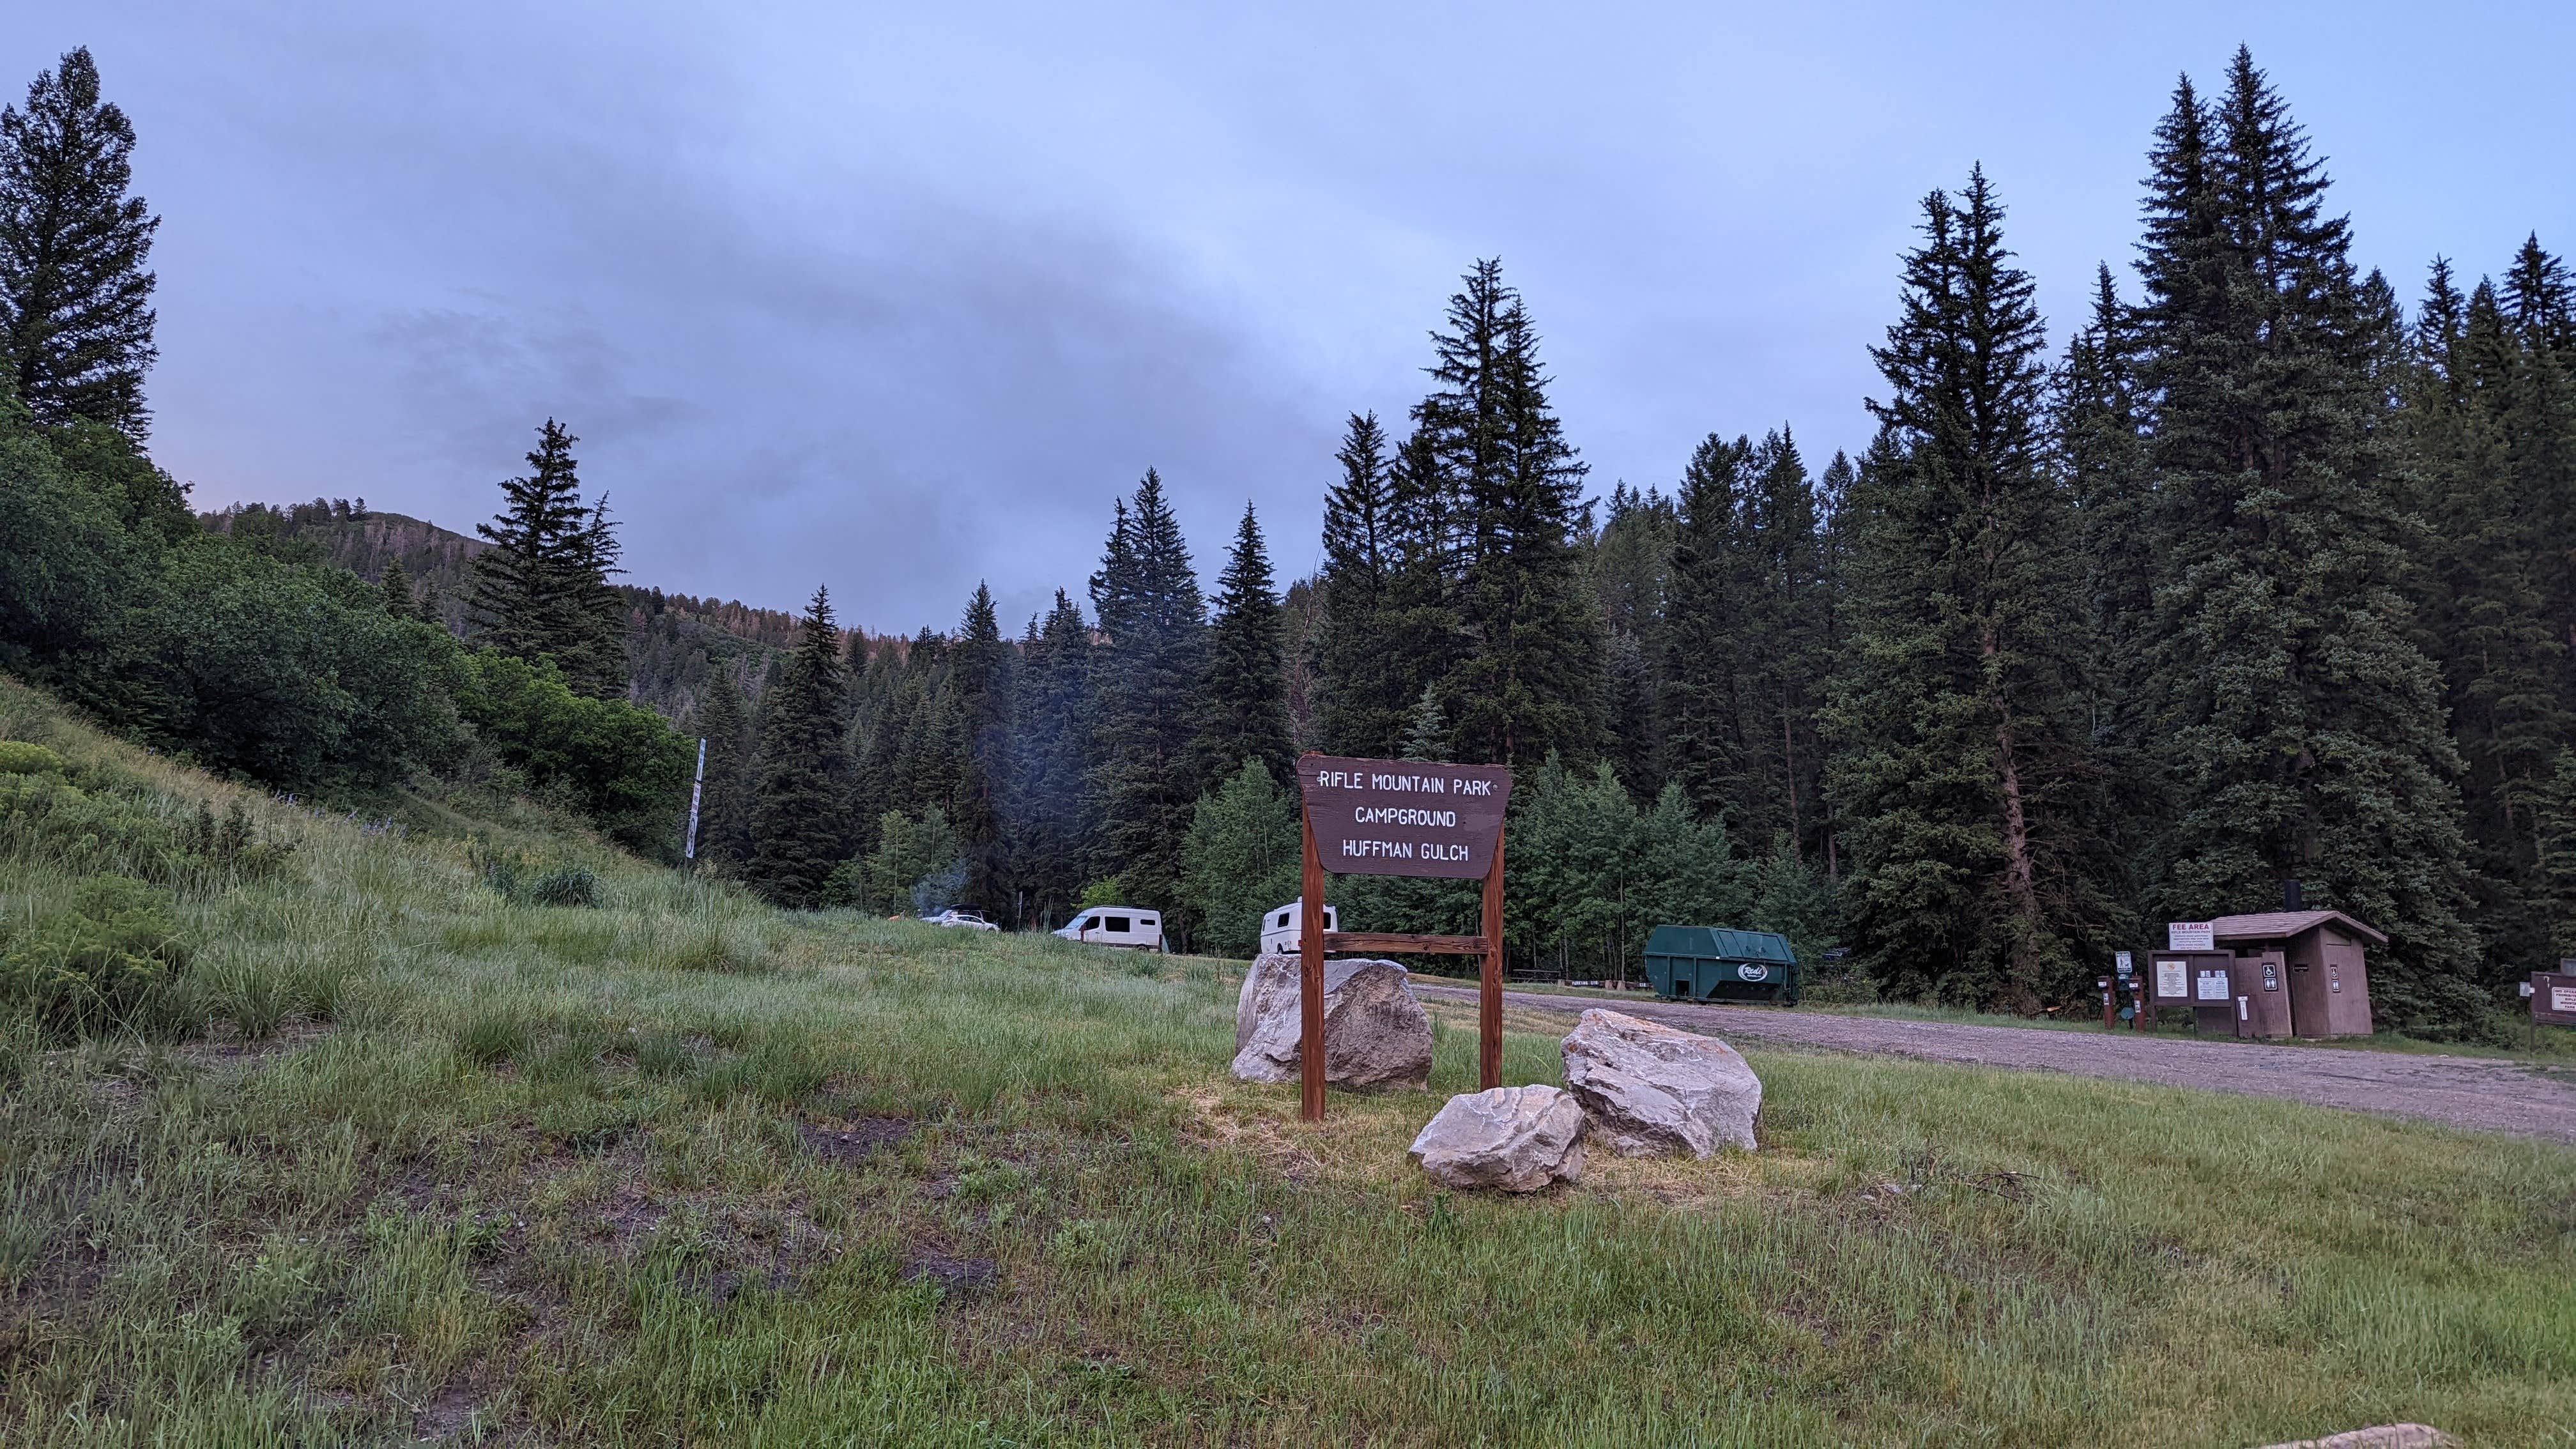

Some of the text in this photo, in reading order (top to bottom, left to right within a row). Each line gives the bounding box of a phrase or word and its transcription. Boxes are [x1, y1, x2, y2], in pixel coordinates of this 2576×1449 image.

[1320, 771, 1492, 796] RIFLE MOUNTAIN PARK
[1355, 807, 1456, 827] CAMPGROUND
[1343, 839, 1468, 861] HUFFMAN GULCH
